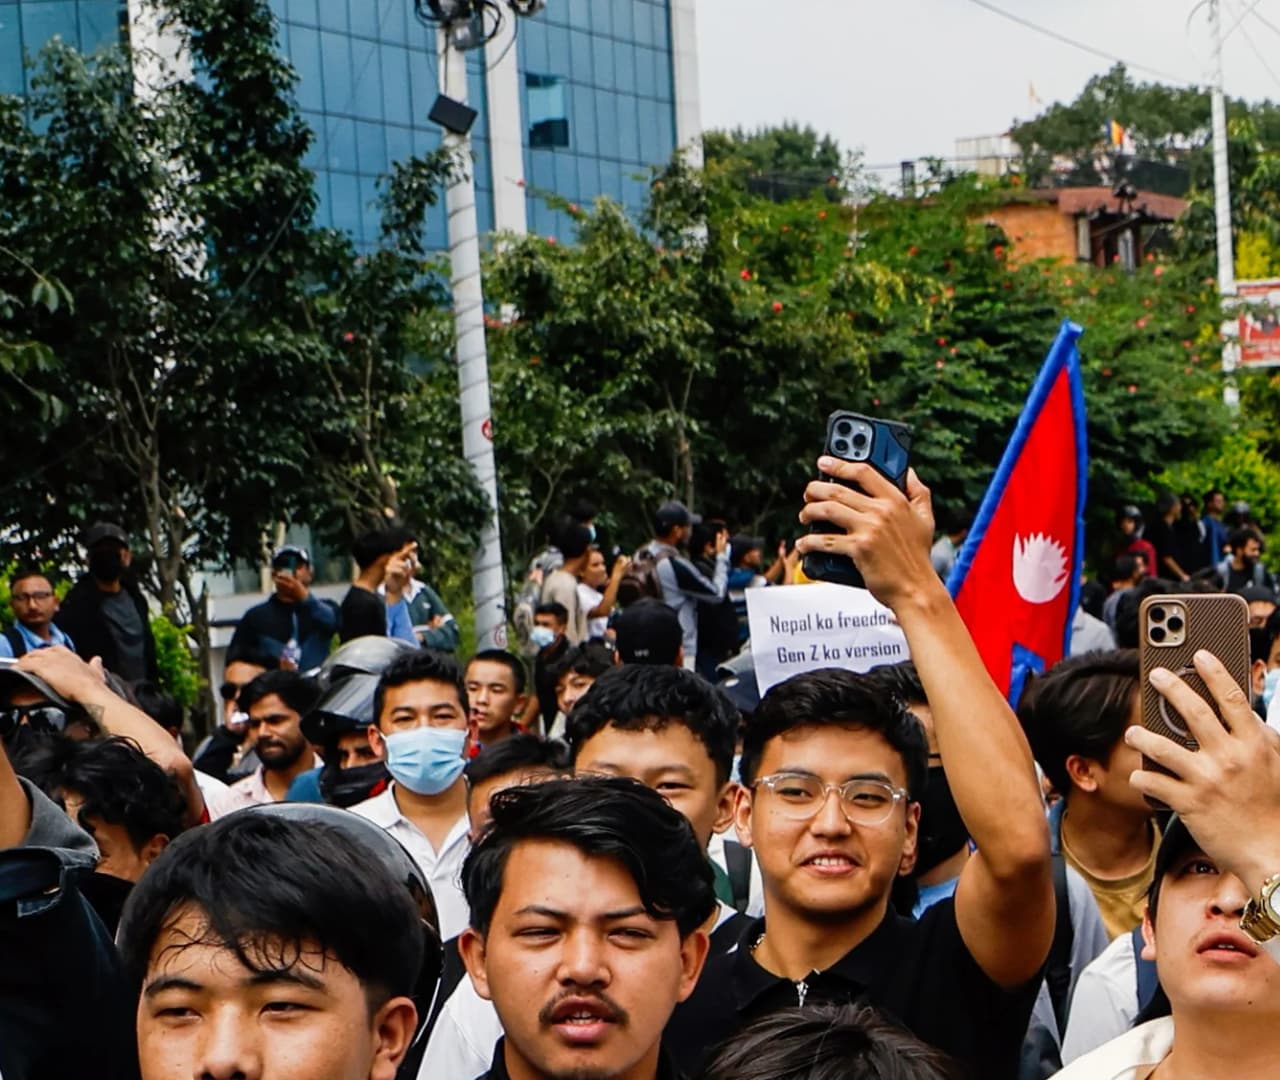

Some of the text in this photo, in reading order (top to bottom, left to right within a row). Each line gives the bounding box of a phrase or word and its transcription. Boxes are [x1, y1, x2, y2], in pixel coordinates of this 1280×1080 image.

[770, 609, 892, 636] Nepal ko freedo
[777, 641, 901, 664] Gen Z ko version
